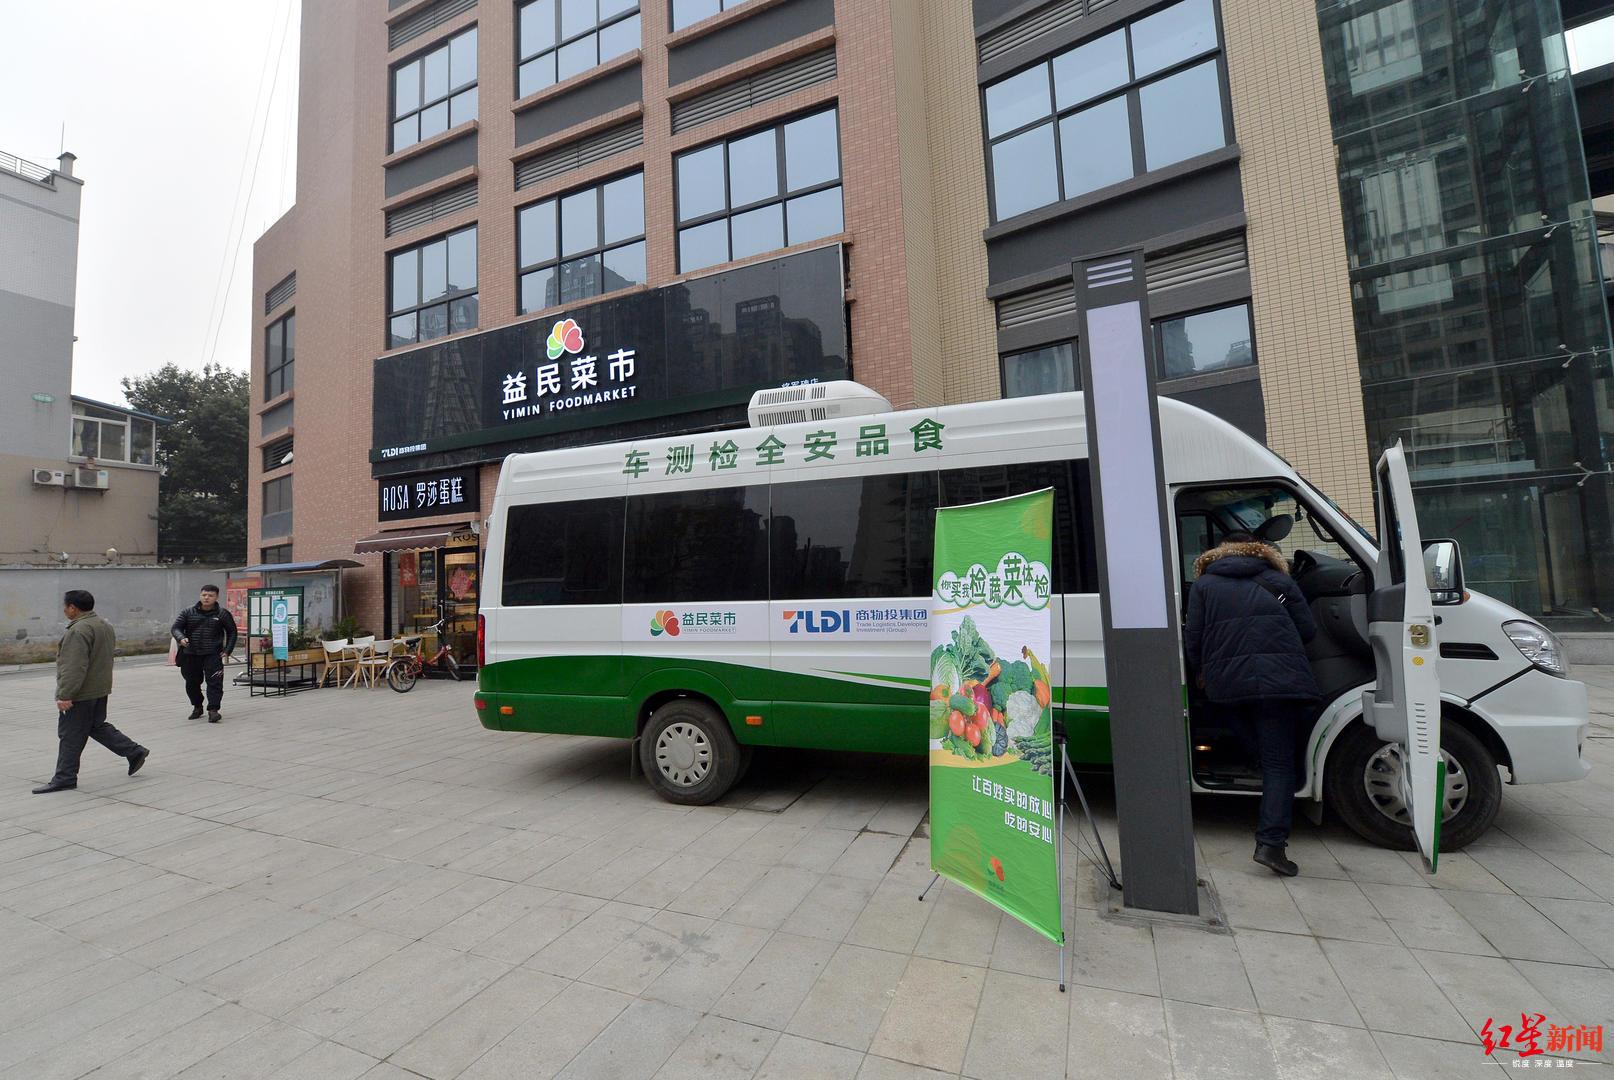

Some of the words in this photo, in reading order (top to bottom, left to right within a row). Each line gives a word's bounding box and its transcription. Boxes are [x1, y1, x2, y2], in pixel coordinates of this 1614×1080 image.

[502, 348, 636, 404] 益民菜市
[503, 404, 540, 420] YIMIN
[549, 385, 637, 412] FOODMARKET
[383, 485, 409, 512] ROSA
[416, 477, 464, 508] 罗莎蛋糕
[682, 612, 736, 626] 益民菜市
[783, 610, 850, 633] TLDI
[856, 608, 928, 621] 商物投集团
[972, 775, 1052, 820] 让百姓买的放心
[1004, 811, 1052, 844] 吃的安心
